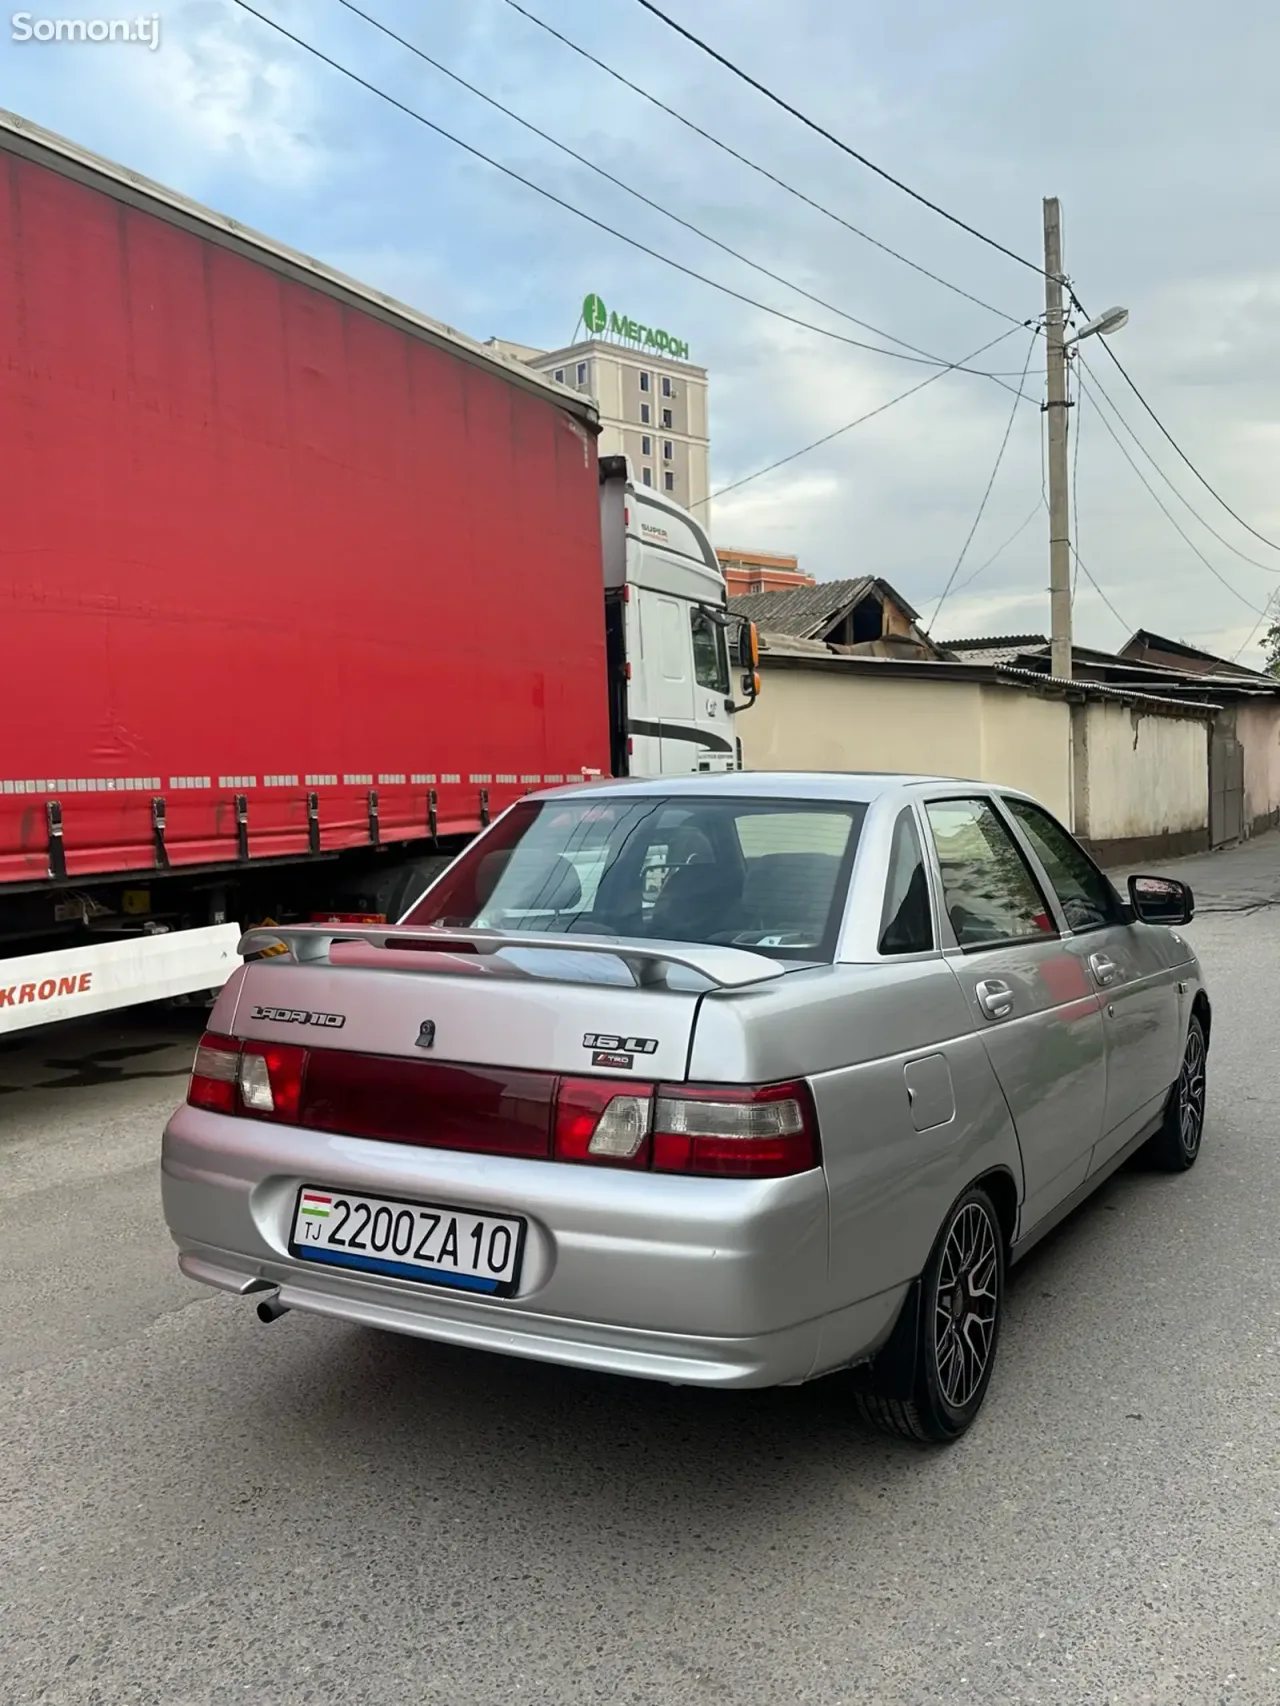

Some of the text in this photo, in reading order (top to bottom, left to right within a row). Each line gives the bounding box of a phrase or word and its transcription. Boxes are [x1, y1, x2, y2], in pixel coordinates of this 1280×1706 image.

[641, 523, 668, 537] SUPER
[0, 972, 92, 1007] KRONE
[251, 1006, 346, 1028] LADA 110
[304, 1221, 322, 1241] TJ
[327, 1199, 512, 1273] 2200ZA10
